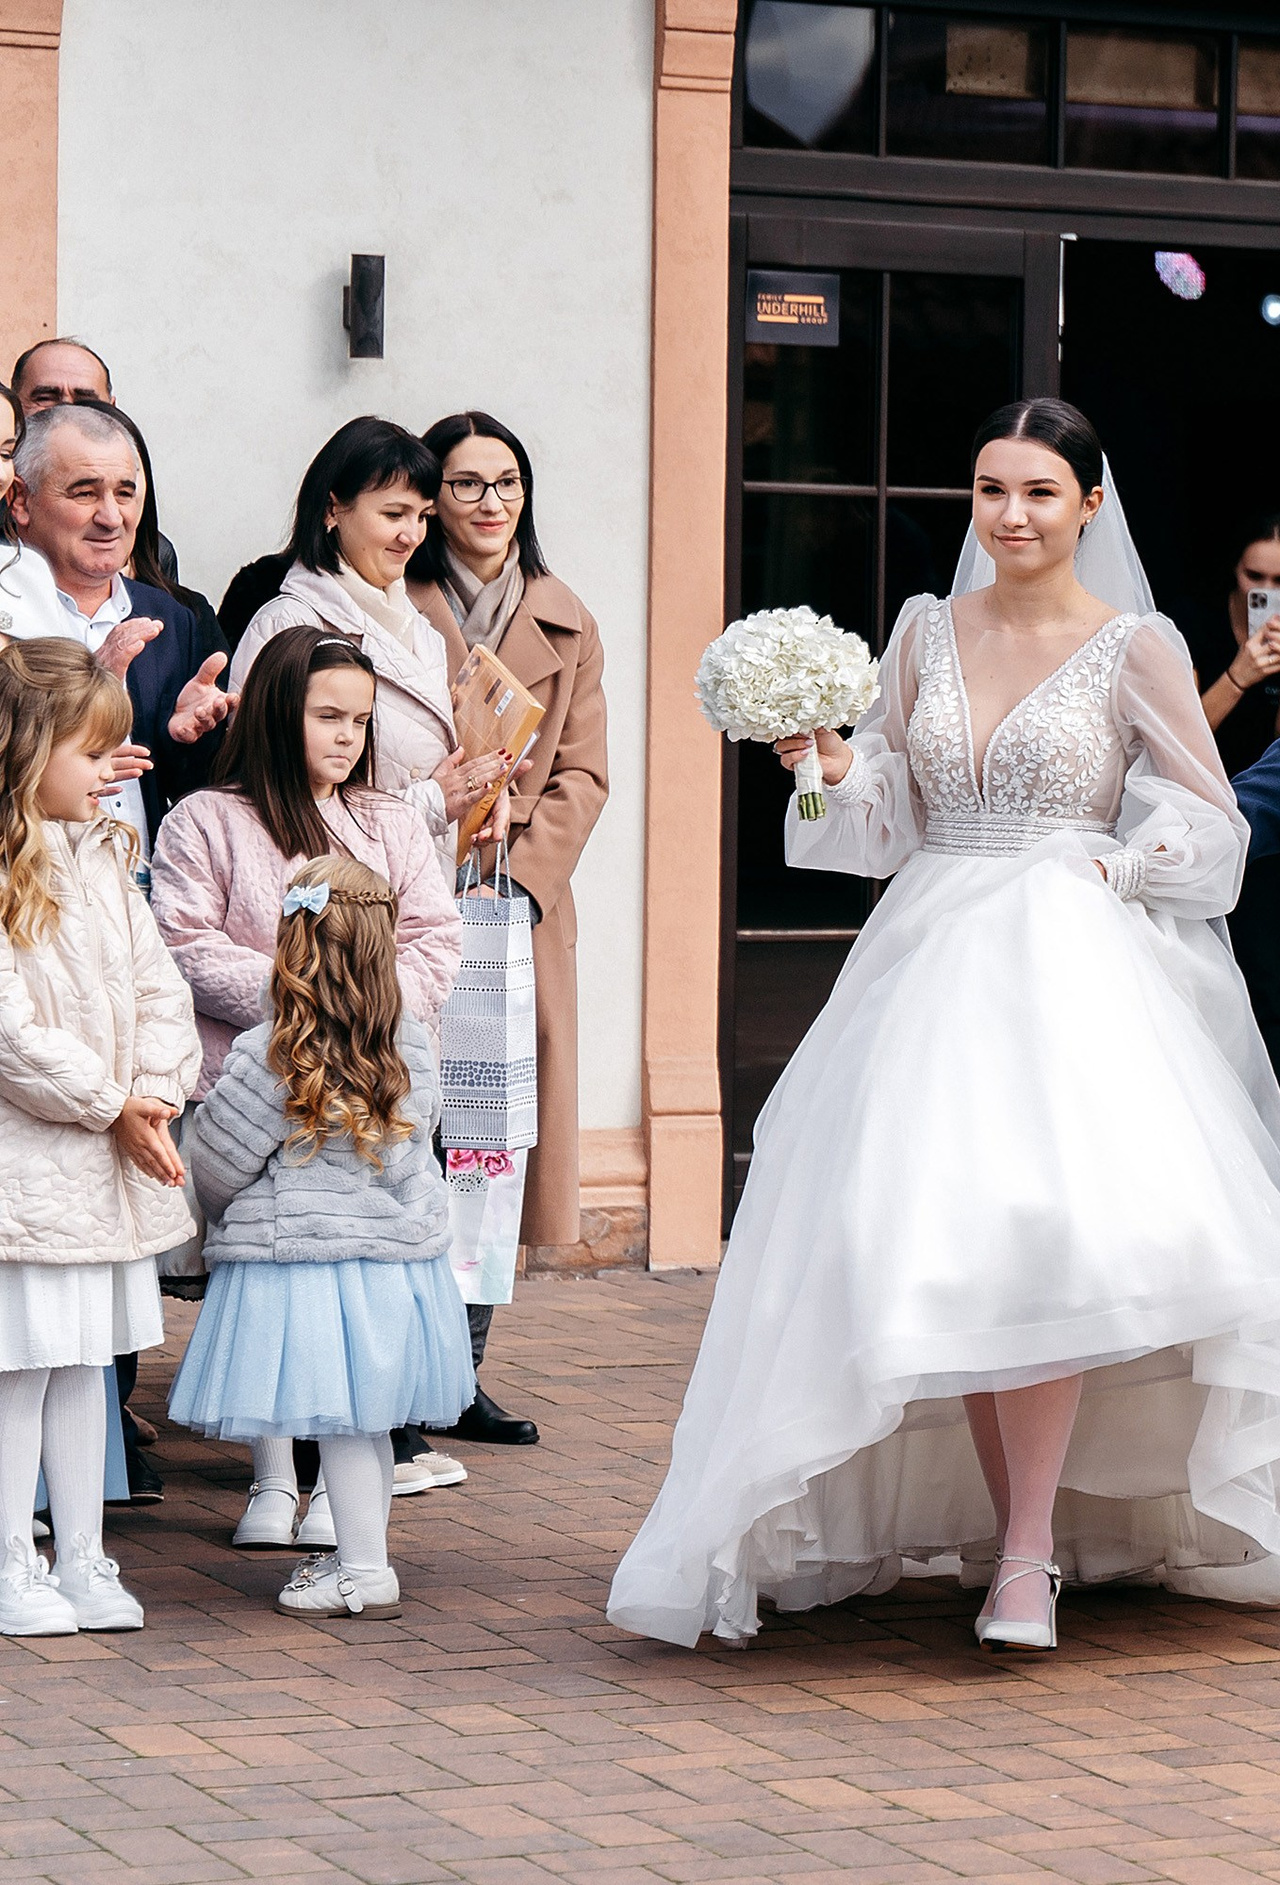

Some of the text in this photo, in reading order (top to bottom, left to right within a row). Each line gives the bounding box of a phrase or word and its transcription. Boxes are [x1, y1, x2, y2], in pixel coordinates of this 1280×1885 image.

[757, 294, 783, 302] FAMILY
[757, 302, 828, 317] UNDERHILL
[800, 317, 828, 325] GROUP
